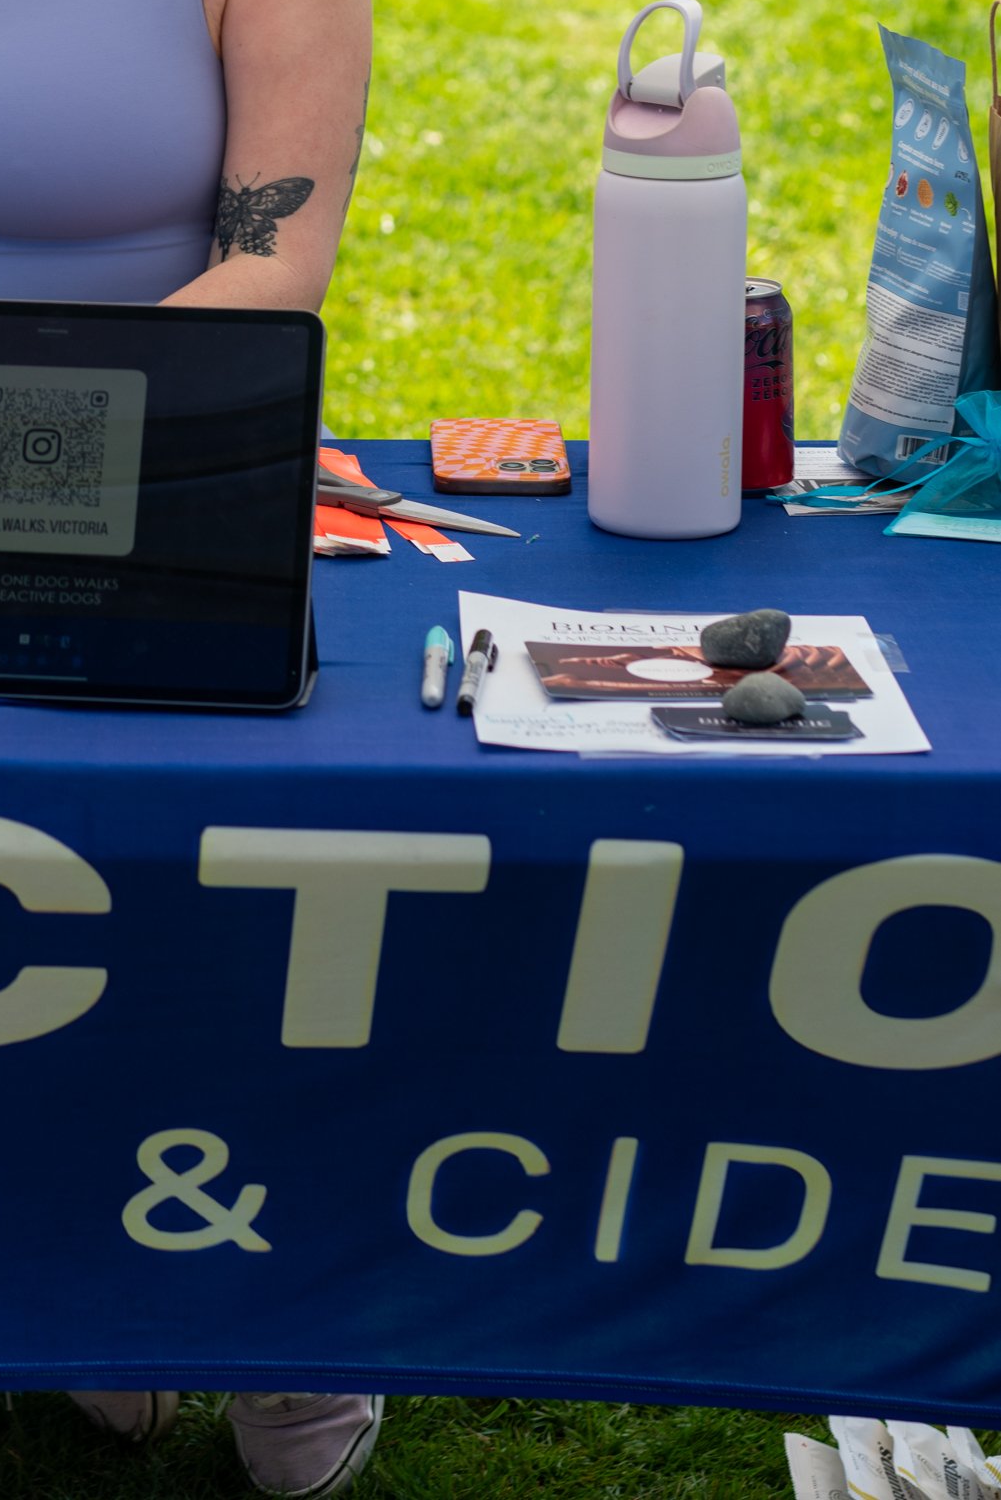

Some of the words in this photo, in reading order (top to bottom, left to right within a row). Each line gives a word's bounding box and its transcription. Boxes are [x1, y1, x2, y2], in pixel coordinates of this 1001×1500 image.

[1, 573, 31, 588] ONE
[34, 575, 69, 588] DOG
[73, 577, 120, 590] WALKS
[60, 591, 103, 605] DOGS
[551, 621, 701, 633] BIOKIN
[123, 1131, 270, 1251] &
[408, 1134, 1001, 1290] CIDE
